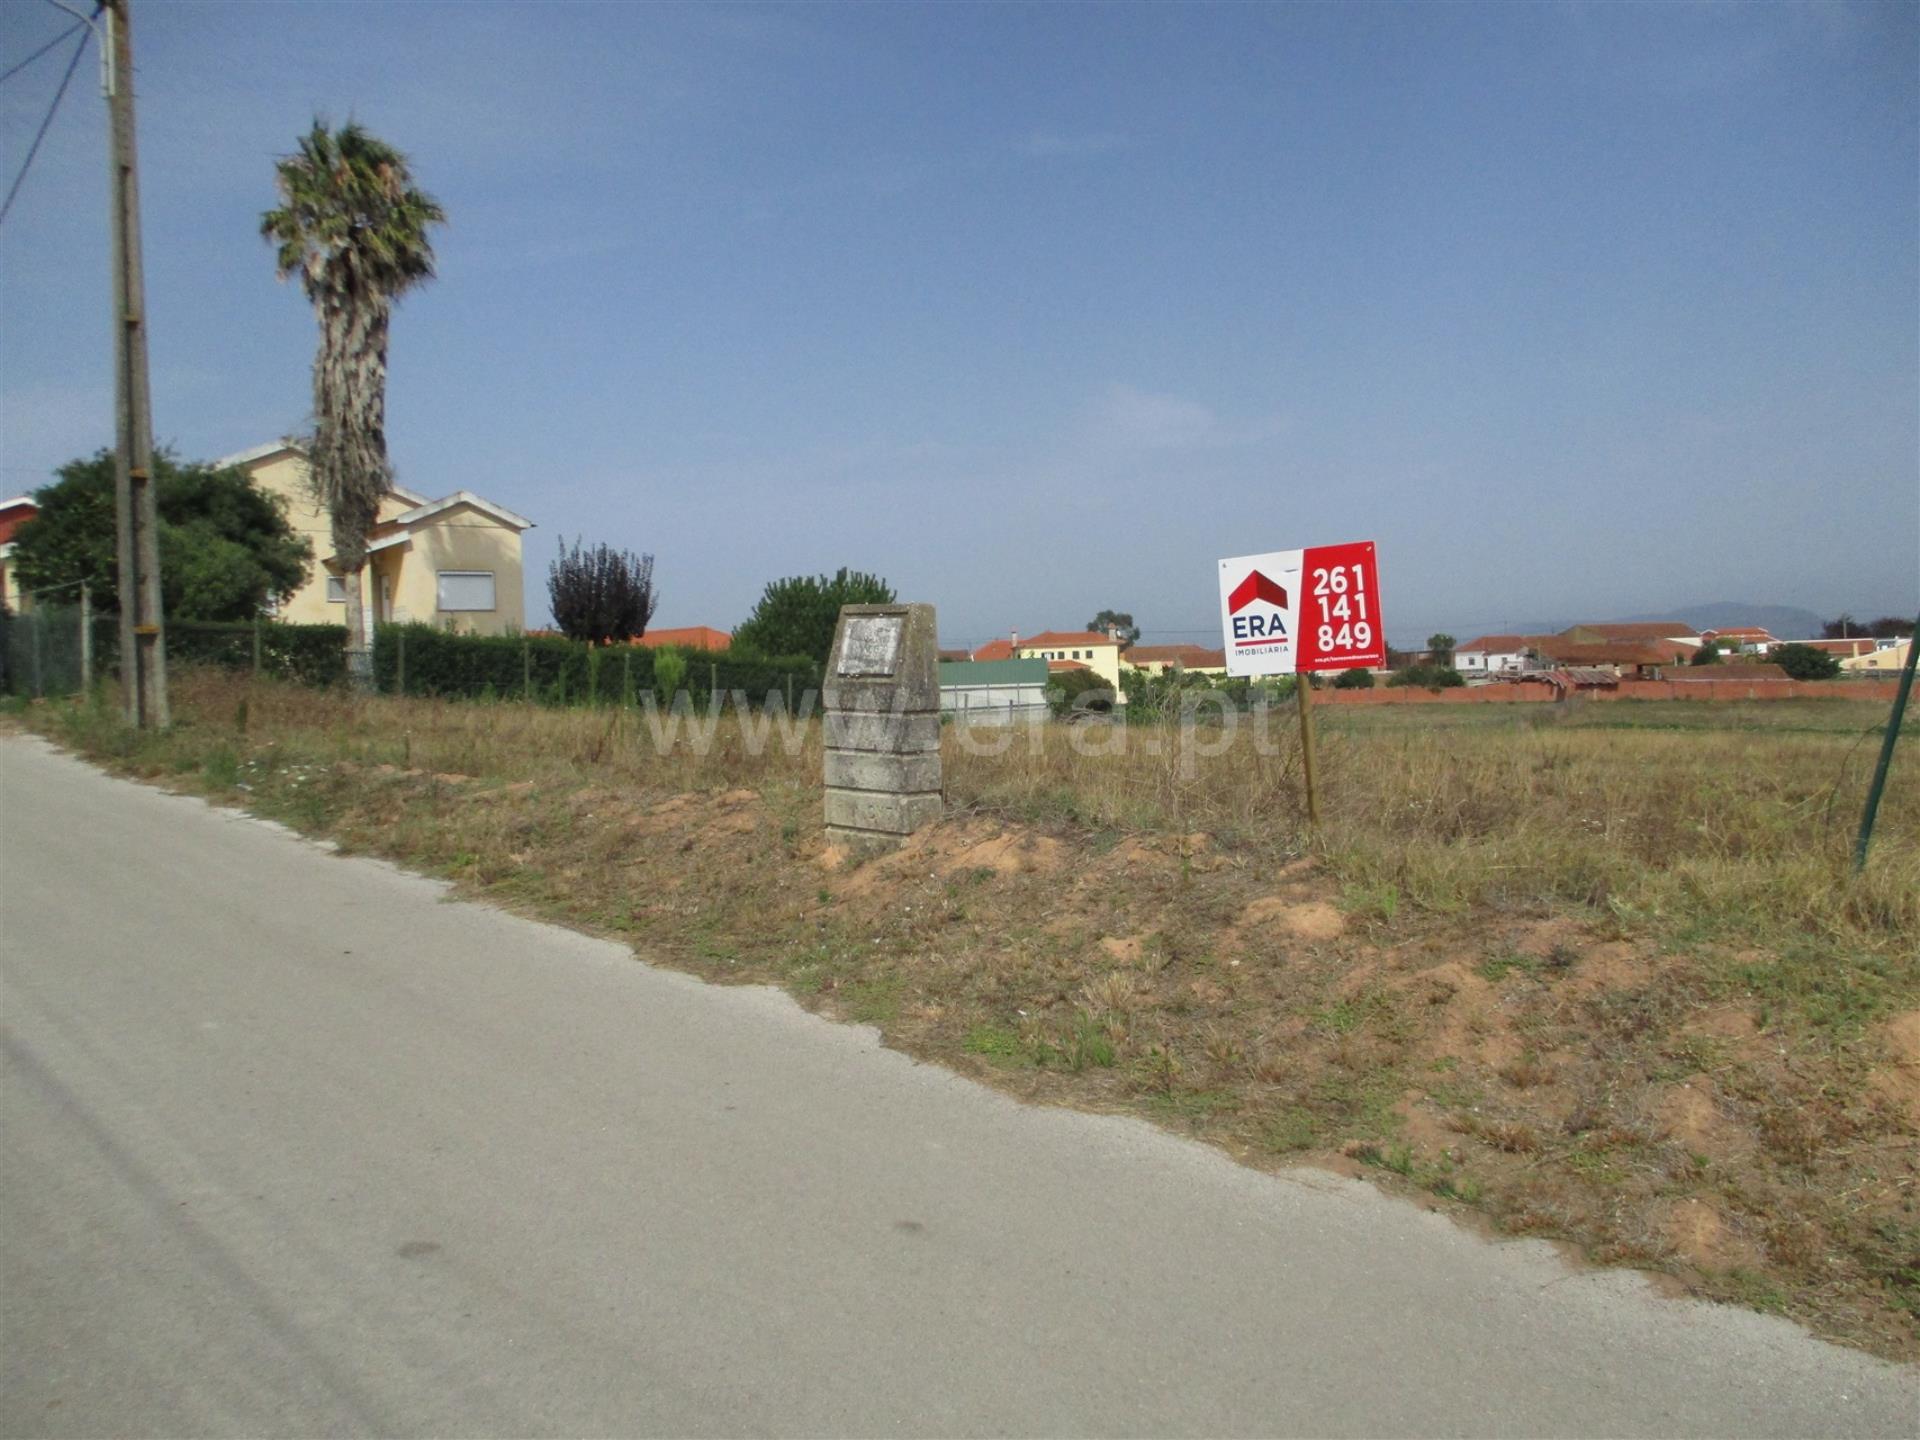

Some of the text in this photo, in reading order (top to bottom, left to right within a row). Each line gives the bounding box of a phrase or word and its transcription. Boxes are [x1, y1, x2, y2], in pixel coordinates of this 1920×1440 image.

[1312, 564, 1365, 596] 261
[1317, 592, 1367, 623] 141
[1232, 613, 1287, 639] ERA
[1317, 621, 1372, 652] 849
[1234, 645, 1290, 657] IMOBILIÁRIA
